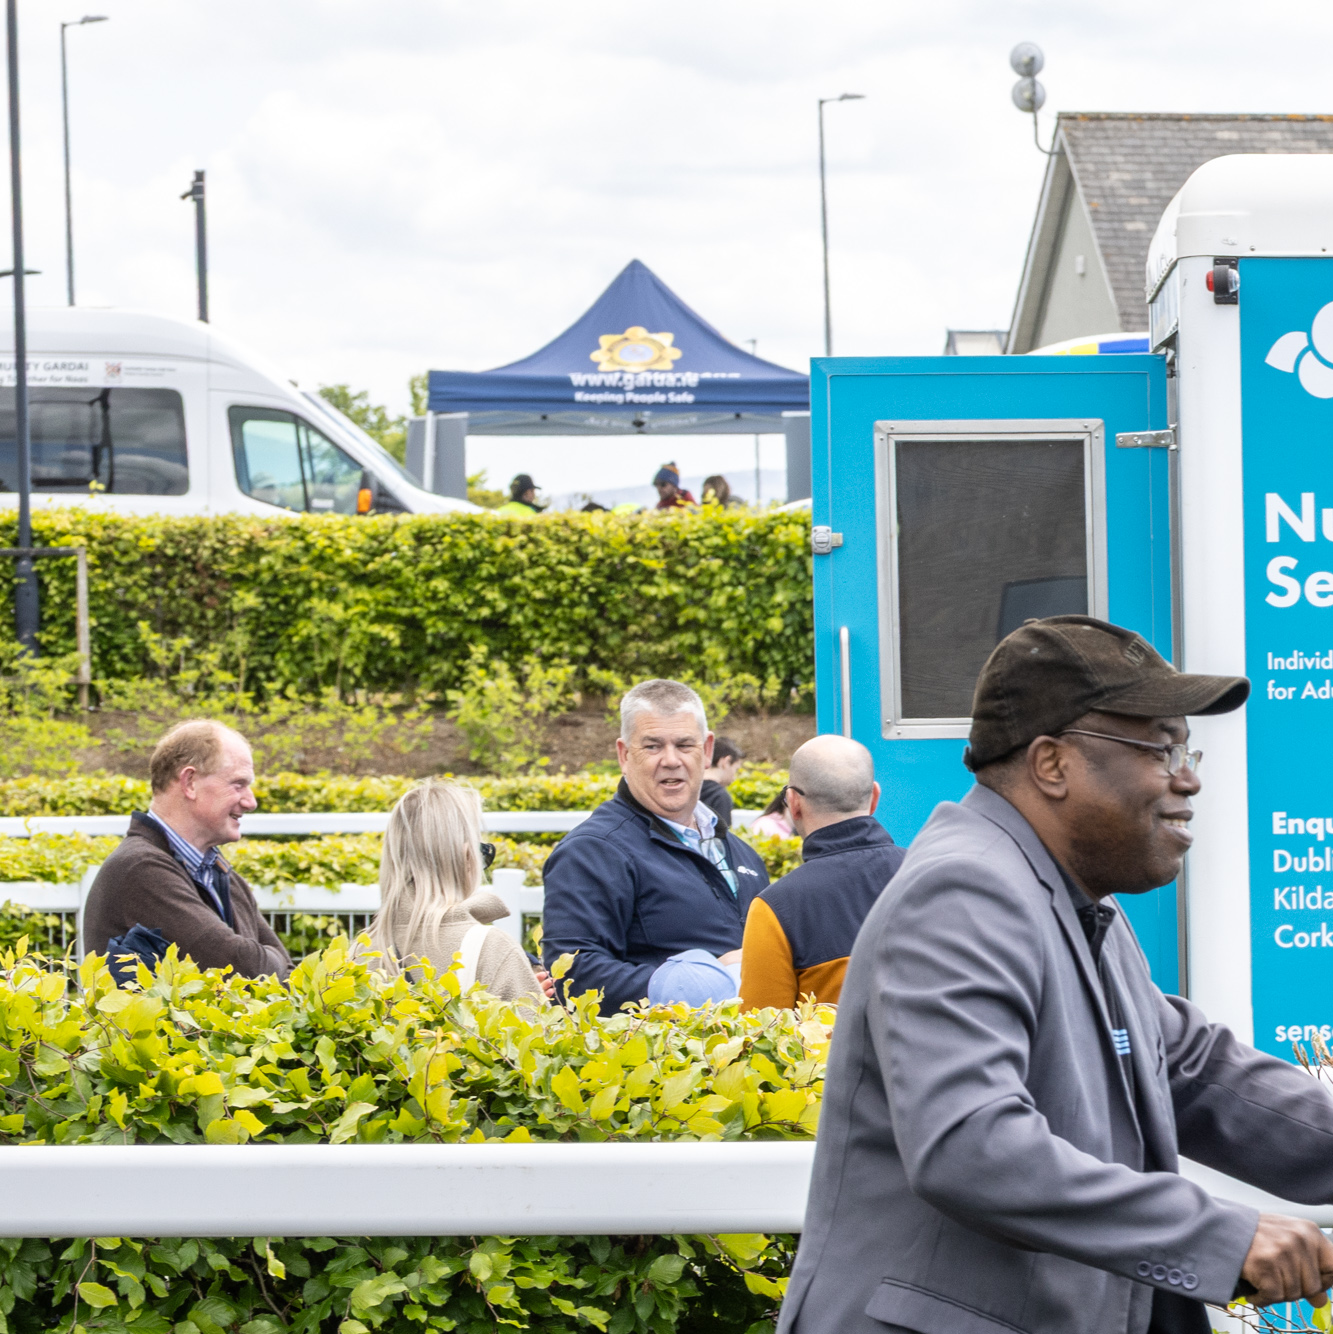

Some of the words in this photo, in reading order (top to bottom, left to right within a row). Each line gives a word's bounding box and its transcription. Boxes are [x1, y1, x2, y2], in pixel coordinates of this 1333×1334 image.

[574, 391, 624, 404] Keeping
[625, 391, 666, 404] People
[667, 391, 696, 404] Safe
[1267, 680, 1296, 699] for
